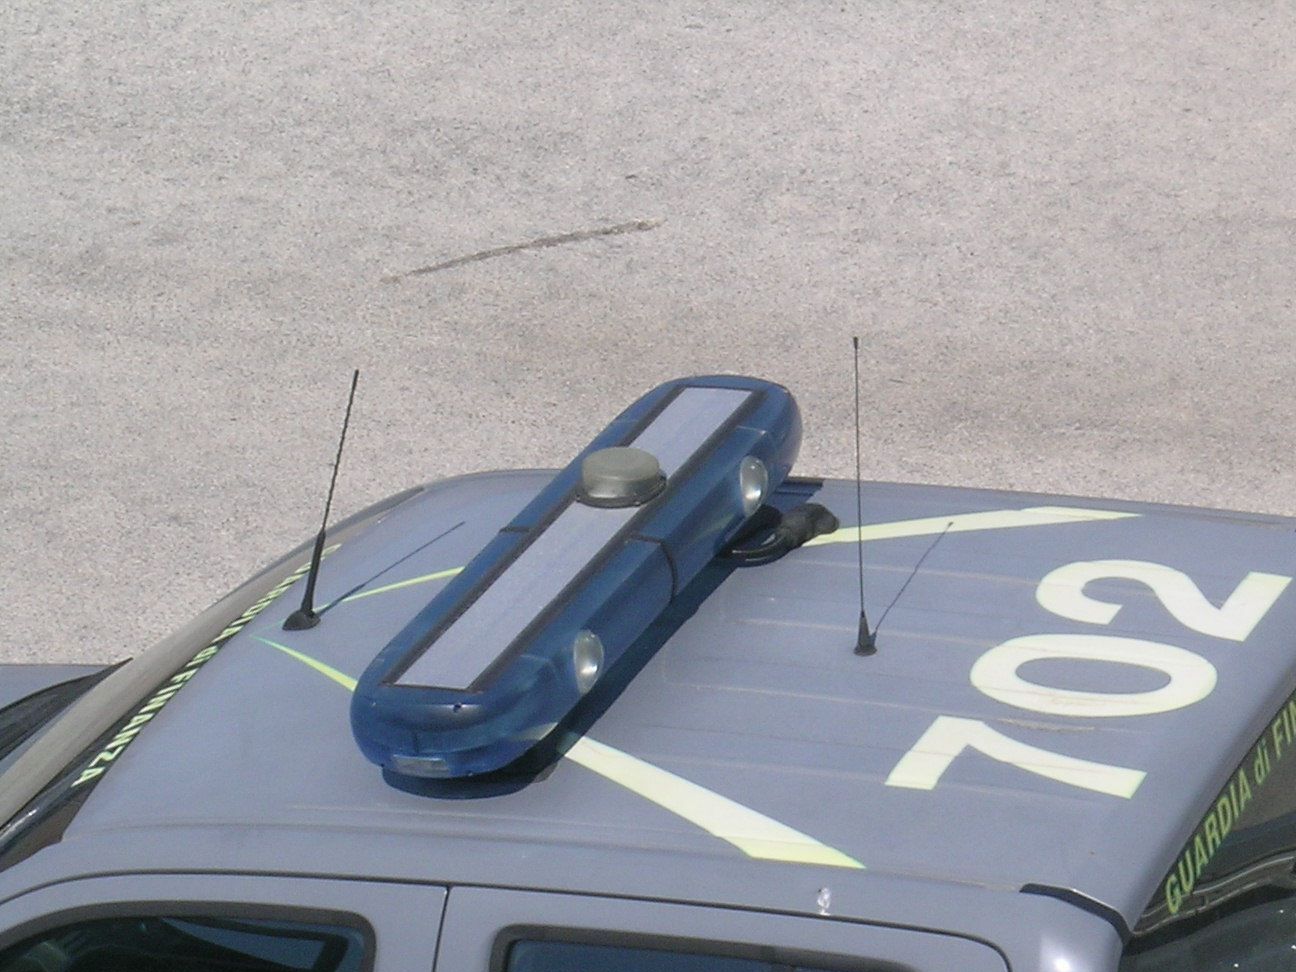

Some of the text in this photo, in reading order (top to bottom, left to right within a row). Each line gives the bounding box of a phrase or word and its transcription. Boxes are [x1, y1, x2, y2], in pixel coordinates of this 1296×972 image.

[71, 668, 200, 788] FINANZA
[885, 559, 1293, 799] 702
[1165, 768, 1252, 914] GUARDIA
[1253, 738, 1271, 786] di
